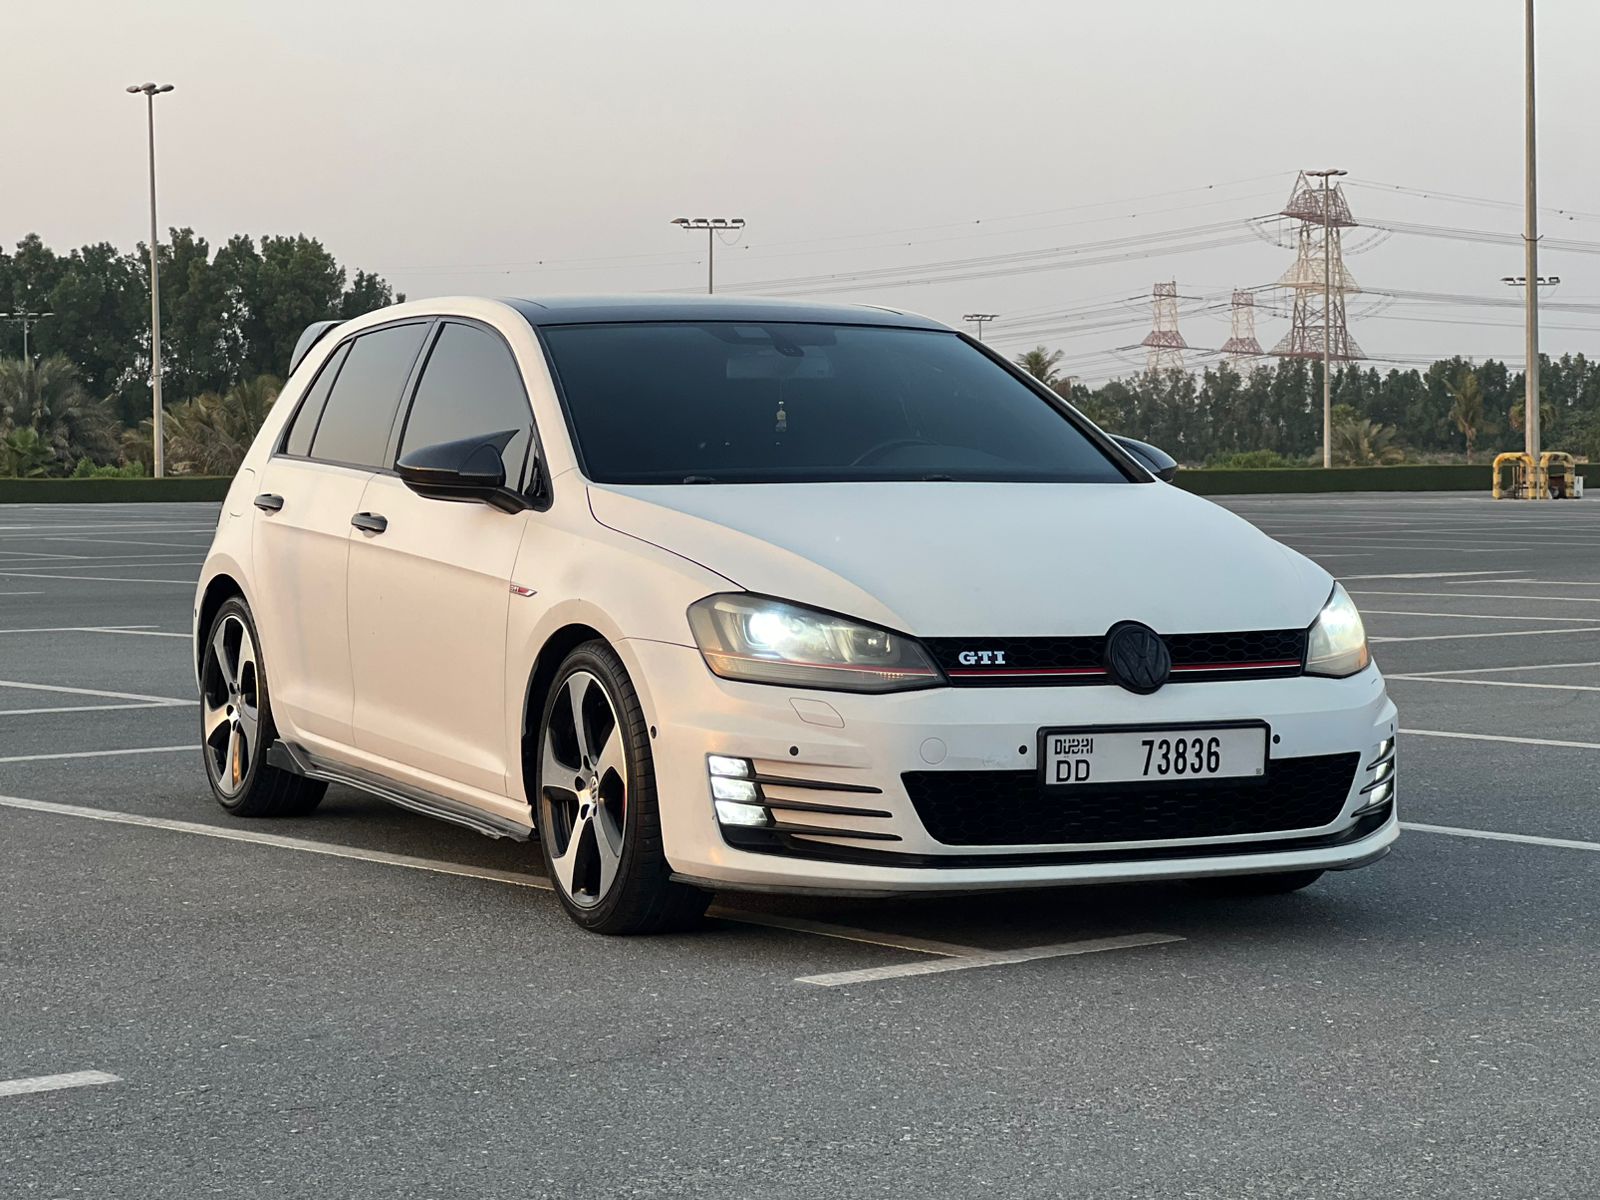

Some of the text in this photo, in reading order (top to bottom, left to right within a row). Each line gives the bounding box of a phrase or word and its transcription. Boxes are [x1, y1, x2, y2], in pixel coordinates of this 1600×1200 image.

[958, 650, 1006, 665] GTI
[1141, 736, 1221, 776] 73836
[1056, 759, 1090, 783] DD
